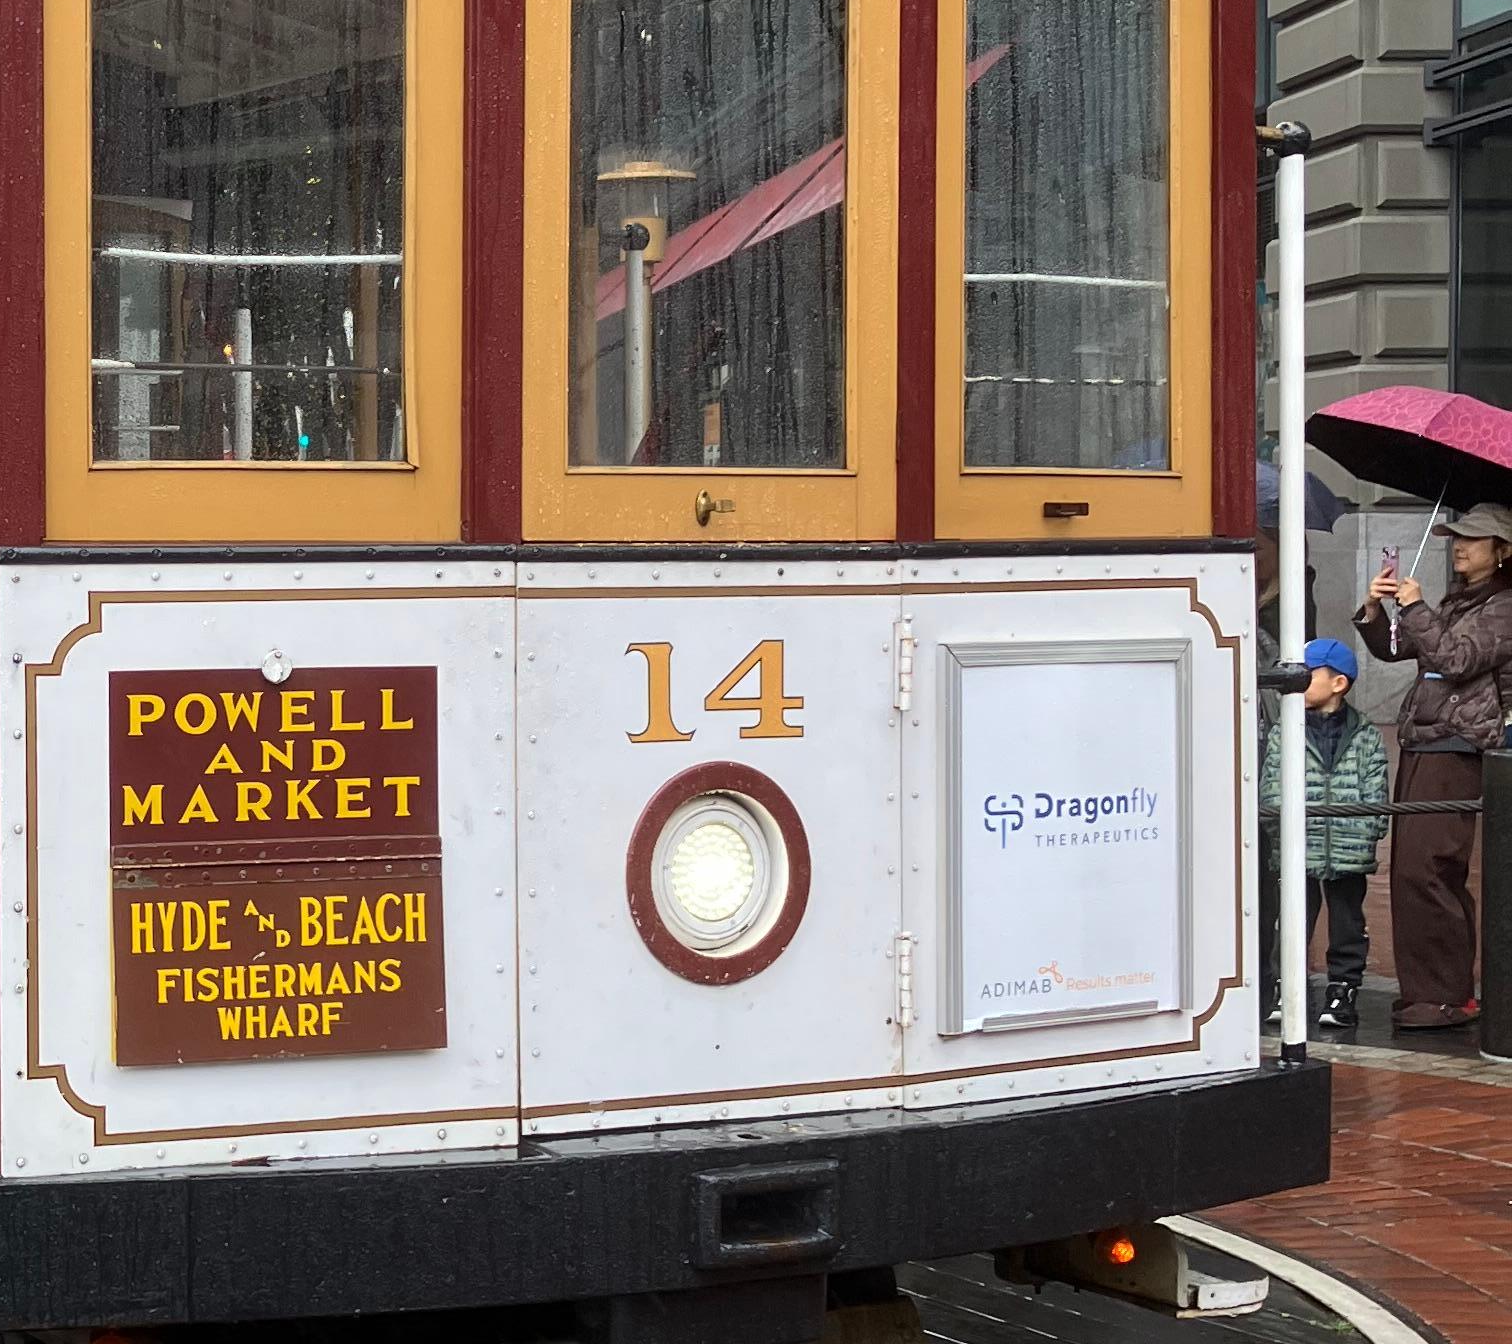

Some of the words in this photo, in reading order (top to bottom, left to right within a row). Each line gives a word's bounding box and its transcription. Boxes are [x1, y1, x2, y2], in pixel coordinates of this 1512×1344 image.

[624, 639, 805, 744] 14
[126, 689, 414, 737] POWELL
[204, 739, 346, 775] AND
[122, 777, 421, 827] MARKET
[1035, 787, 1158, 824] Dragonfly
[1035, 827, 1159, 847] THERAPEUTICS
[130, 900, 232, 954] HYDE
[244, 899, 291, 948] AND
[299, 892, 427, 947] BEACH
[157, 959, 402, 1004] FISHERMANS
[981, 978, 1052, 999] ADIMAB
[1066, 974, 1112, 992] Results
[1115, 971, 1156, 985] matter
[217, 1002, 345, 1041] WHARF
